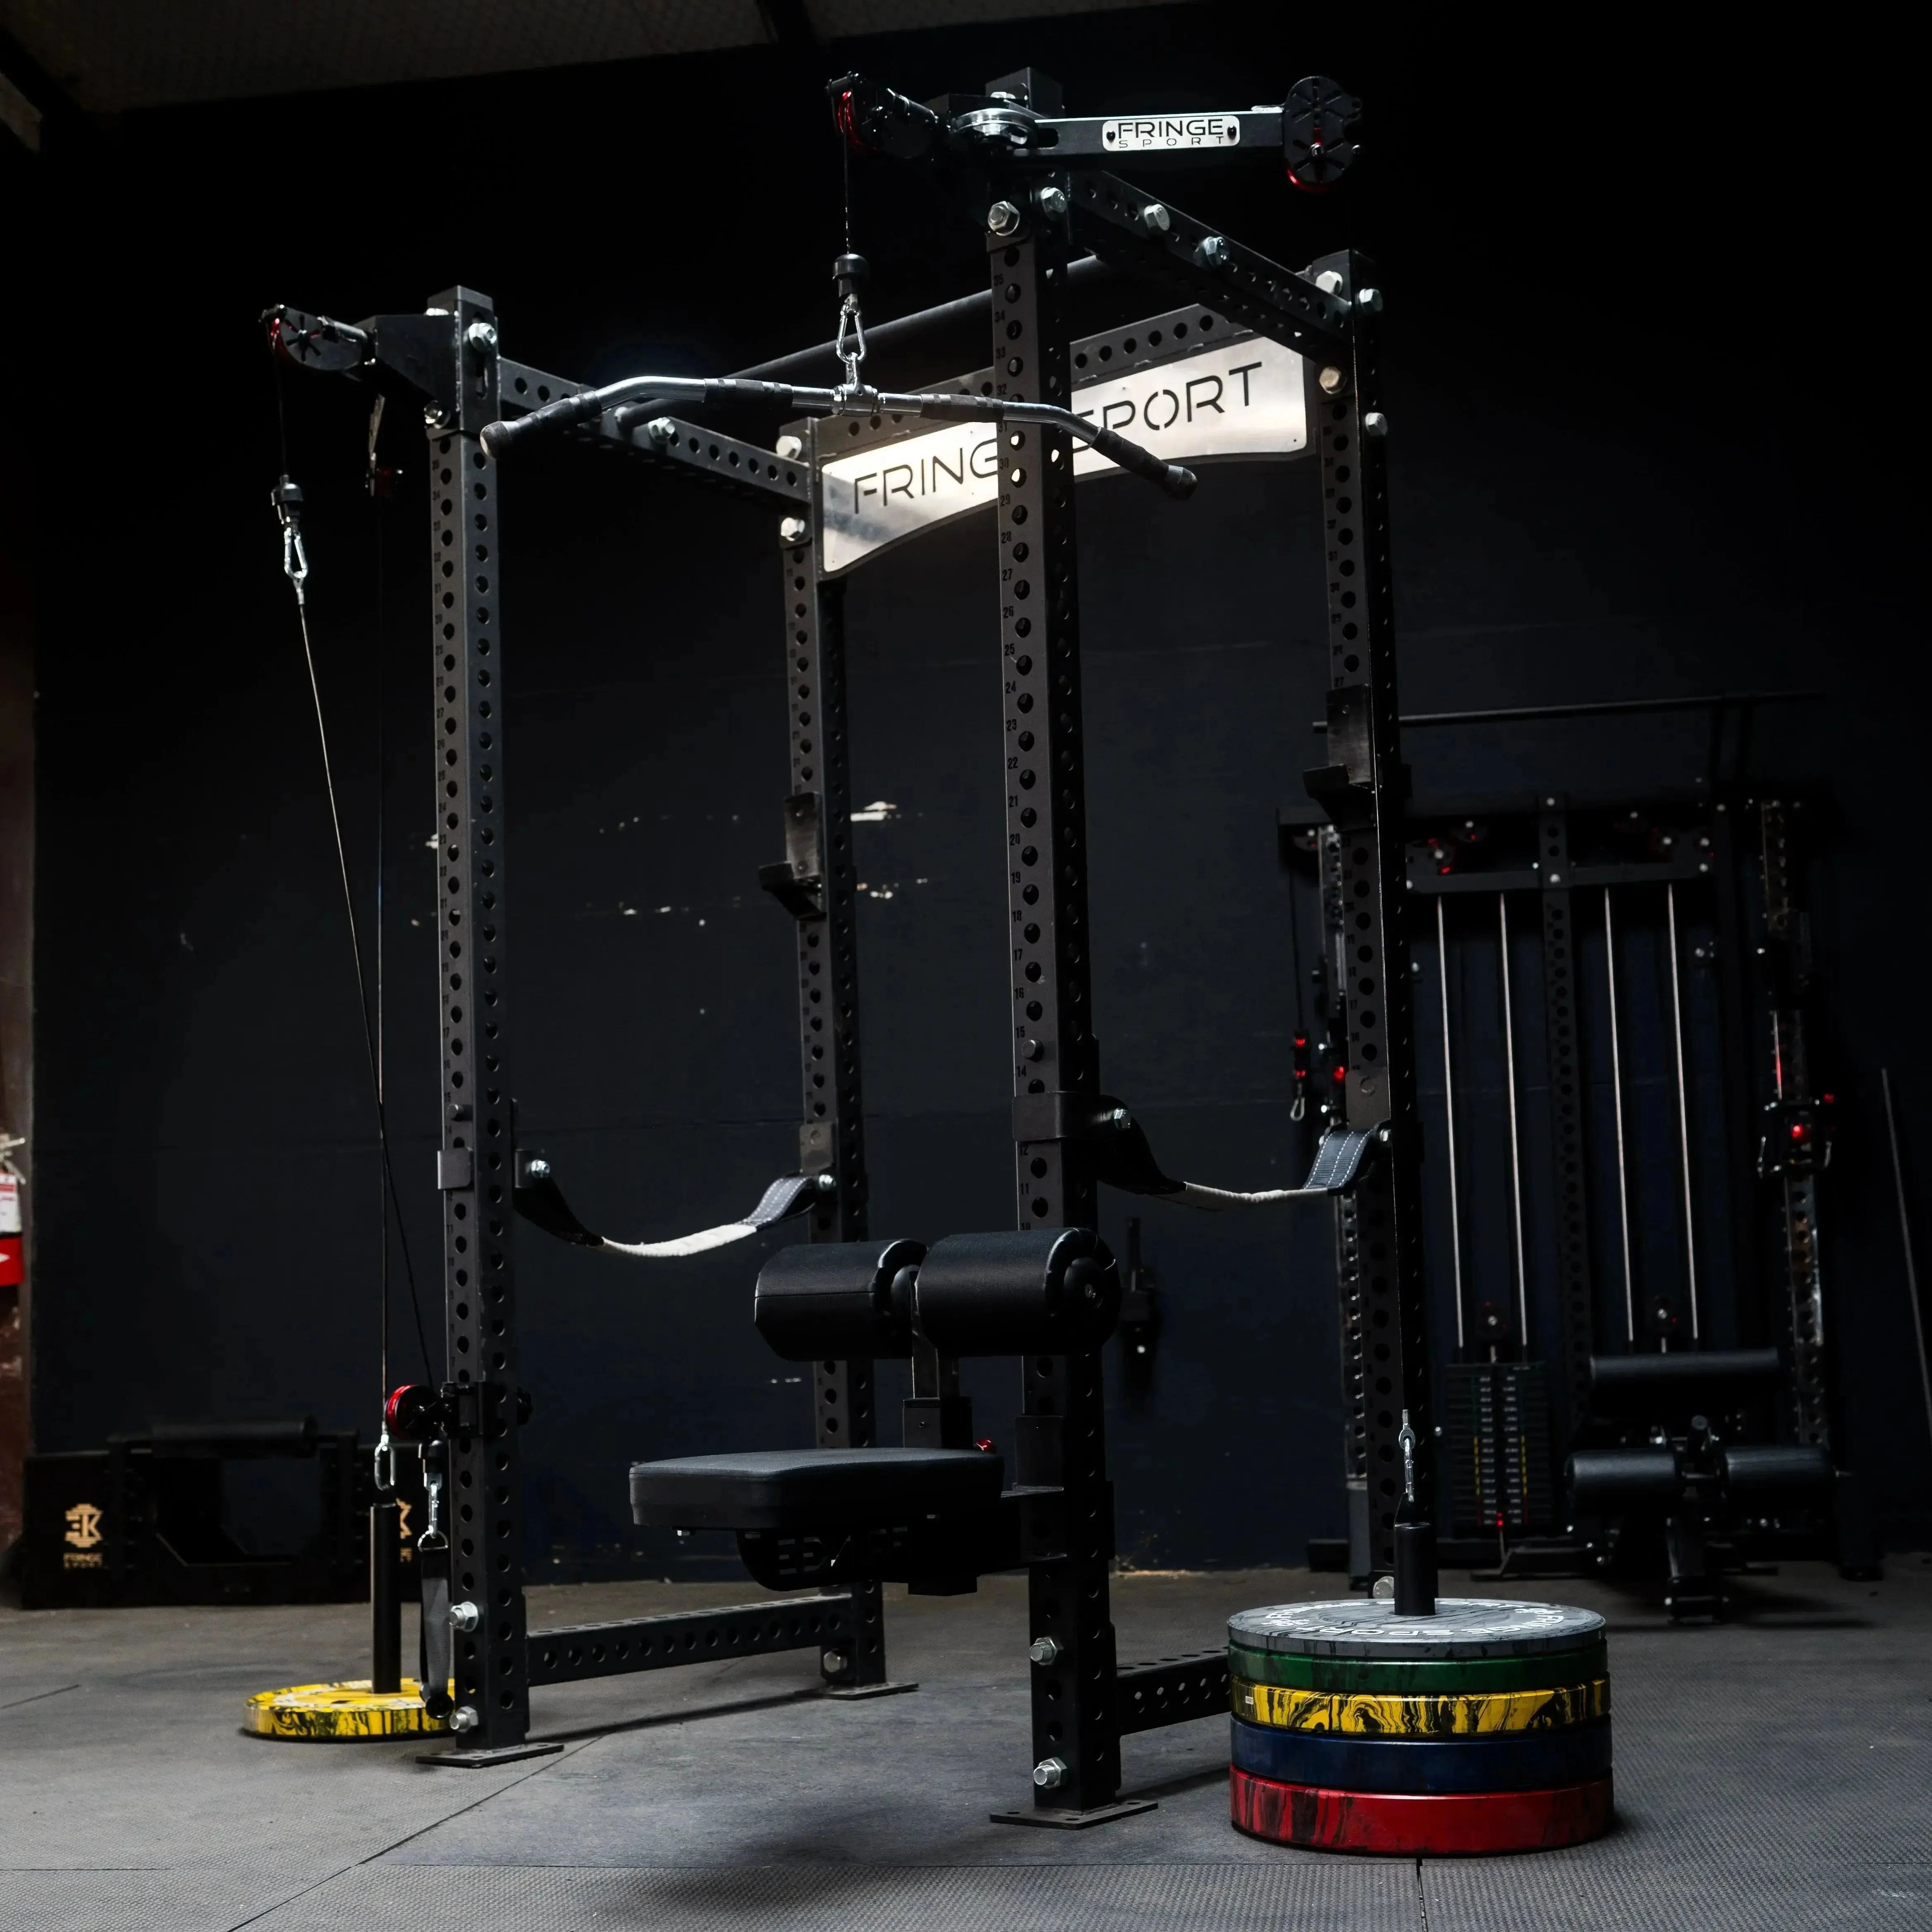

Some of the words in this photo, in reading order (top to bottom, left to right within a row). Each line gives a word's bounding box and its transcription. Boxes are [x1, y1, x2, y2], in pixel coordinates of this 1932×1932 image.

[1118, 119, 1223, 139] FRINGE
[1119, 136, 1224, 148] SPORT
[997, 384, 1007, 396] 32
[998, 423, 1007, 433] 31
[854, 438, 998, 514] FRING
[1073, 361, 1262, 454] PORT
[999, 457, 1009, 469] 30
[1000, 494, 1010, 507] 29
[1002, 569, 1012, 581] 27
[1004, 606, 1014, 619] 26
[1005, 644, 1015, 655] 25
[1006, 681, 1016, 693] 24
[1007, 719, 1016, 731] 23
[1008, 757, 1018, 769] 22
[1009, 796, 1018, 807] 21
[1010, 834, 1020, 846] 20
[1011, 872, 1020, 884] 19
[1012, 911, 1021, 922] 18
[1014, 949, 1023, 961] 17
[1014, 988, 1024, 999] 16
[1016, 1026, 1025, 1038] 15
[1016, 1066, 1026, 1077] 14
[445, 1092, 451, 1102] 15
[1019, 1143, 1028, 1155] 12
[1021, 1183, 1028, 1195] 11
[1296, 1626, 1455, 1636] SPORT
[1461, 1615, 1564, 1635] FRINGE
